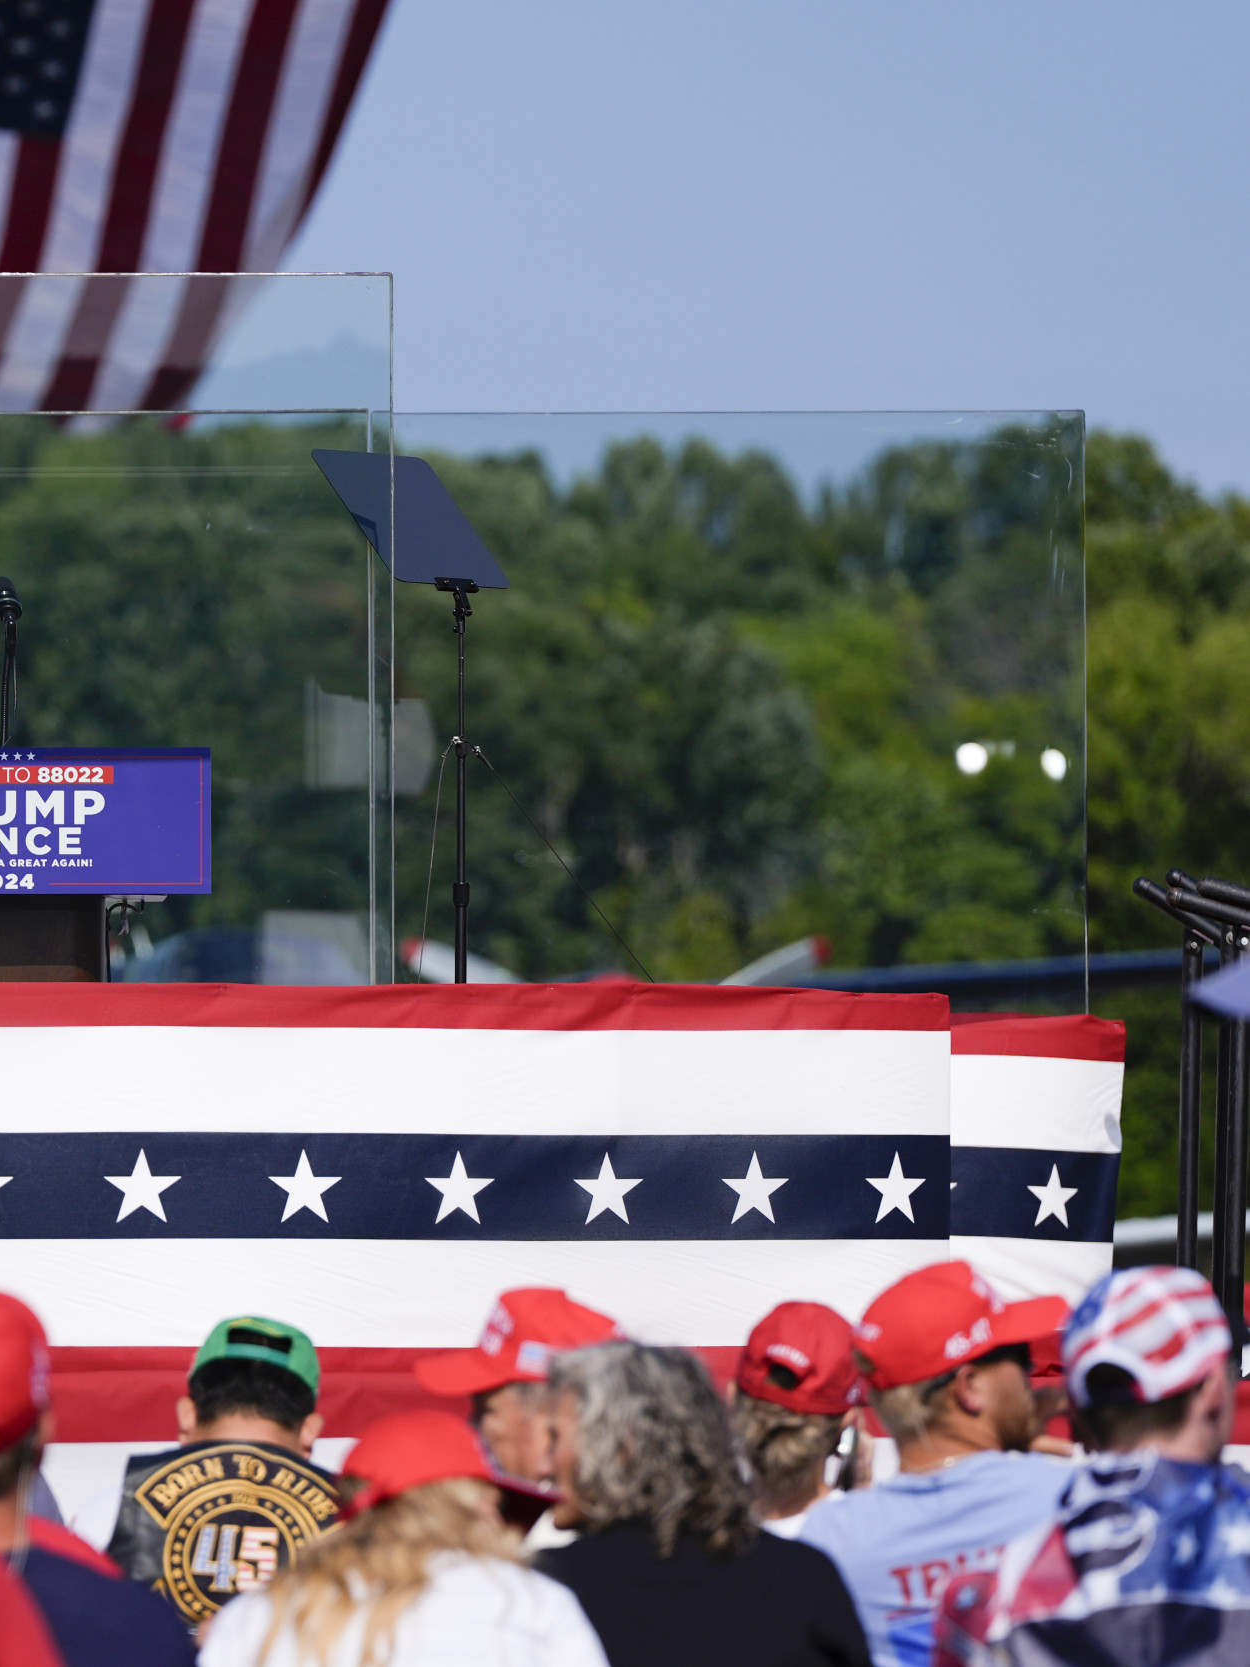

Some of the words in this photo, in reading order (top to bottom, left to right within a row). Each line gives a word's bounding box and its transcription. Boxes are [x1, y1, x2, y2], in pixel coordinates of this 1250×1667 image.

[2, 767, 30, 783] TO
[37, 767, 104, 783] 88022
[9, 858, 48, 868] GREAT
[51, 858, 93, 868] AGAIN!
[149, 1456, 225, 1508] BORN
[232, 1453, 267, 1483] TO
[270, 1467, 340, 1521] RIDE
[191, 1522, 279, 1593] 45
